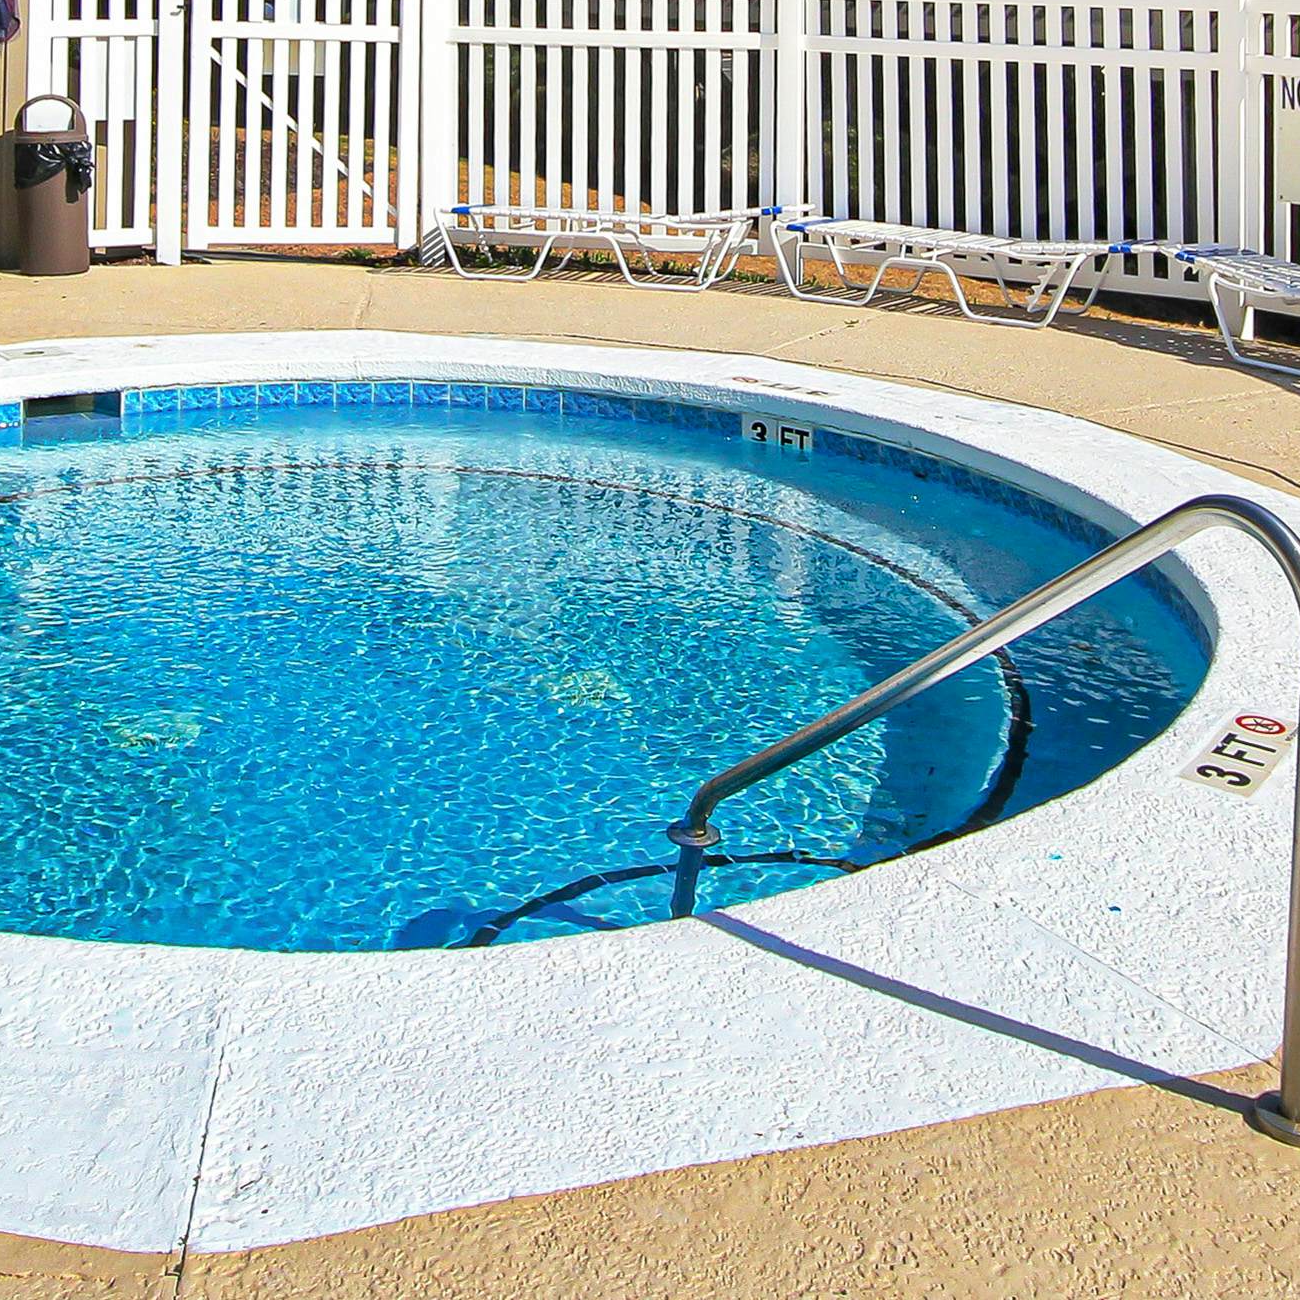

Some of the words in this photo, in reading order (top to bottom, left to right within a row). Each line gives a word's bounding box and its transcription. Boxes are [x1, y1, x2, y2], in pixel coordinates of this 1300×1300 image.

[751, 421, 767, 442] 3
[781, 426, 810, 450] FT
[1211, 732, 1277, 767] FT
[1196, 765, 1251, 787] 3
